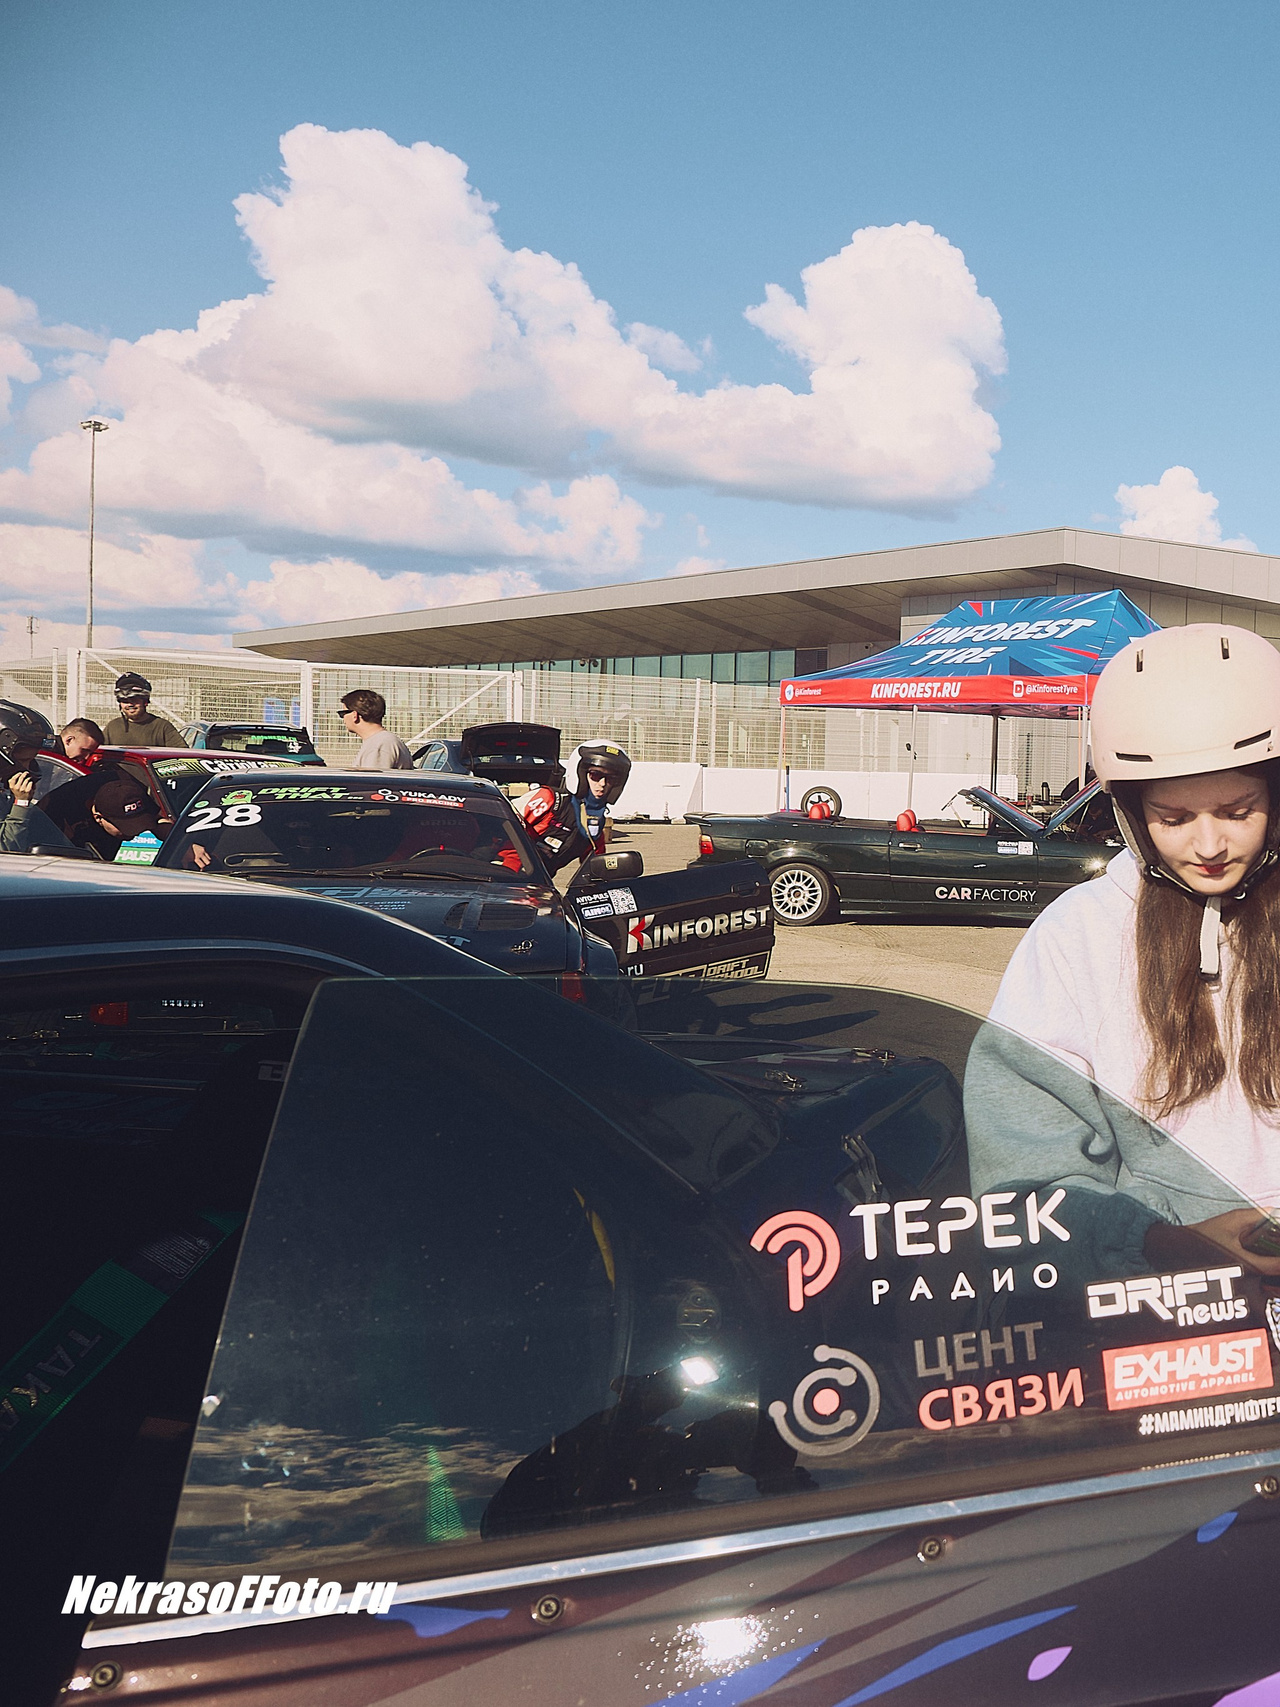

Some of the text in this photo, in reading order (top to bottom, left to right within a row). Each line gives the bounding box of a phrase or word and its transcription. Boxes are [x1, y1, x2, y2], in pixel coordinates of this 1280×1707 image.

[902, 618, 1098, 648] KINFOREST
[910, 646, 1008, 666] TYRE
[870, 681, 962, 699] KINFOREST.RU
[1025, 683, 1079, 696] @KinforestTyre
[258, 787, 348, 795] DRIFT
[400, 790, 466, 803] YUKA ADV
[425, 799, 460, 807] RACING
[185, 804, 263, 833] 28
[527, 797, 549, 817] 43
[626, 905, 771, 954] KINFOREST
[706, 958, 750, 977] DRIFT
[849, 1188, 1071, 1261] ТЕРЕК
[871, 1263, 1059, 1306] РАДИО
[1177, 1299, 1249, 1327] news
[914, 1321, 1044, 1381] ЦЕНТ
[1113, 1337, 1262, 1390] EXHAUST
[918, 1367, 1085, 1431] СВЯЗИ
[1116, 1373, 1256, 1401] AUTOMOTIVE APPAREL
